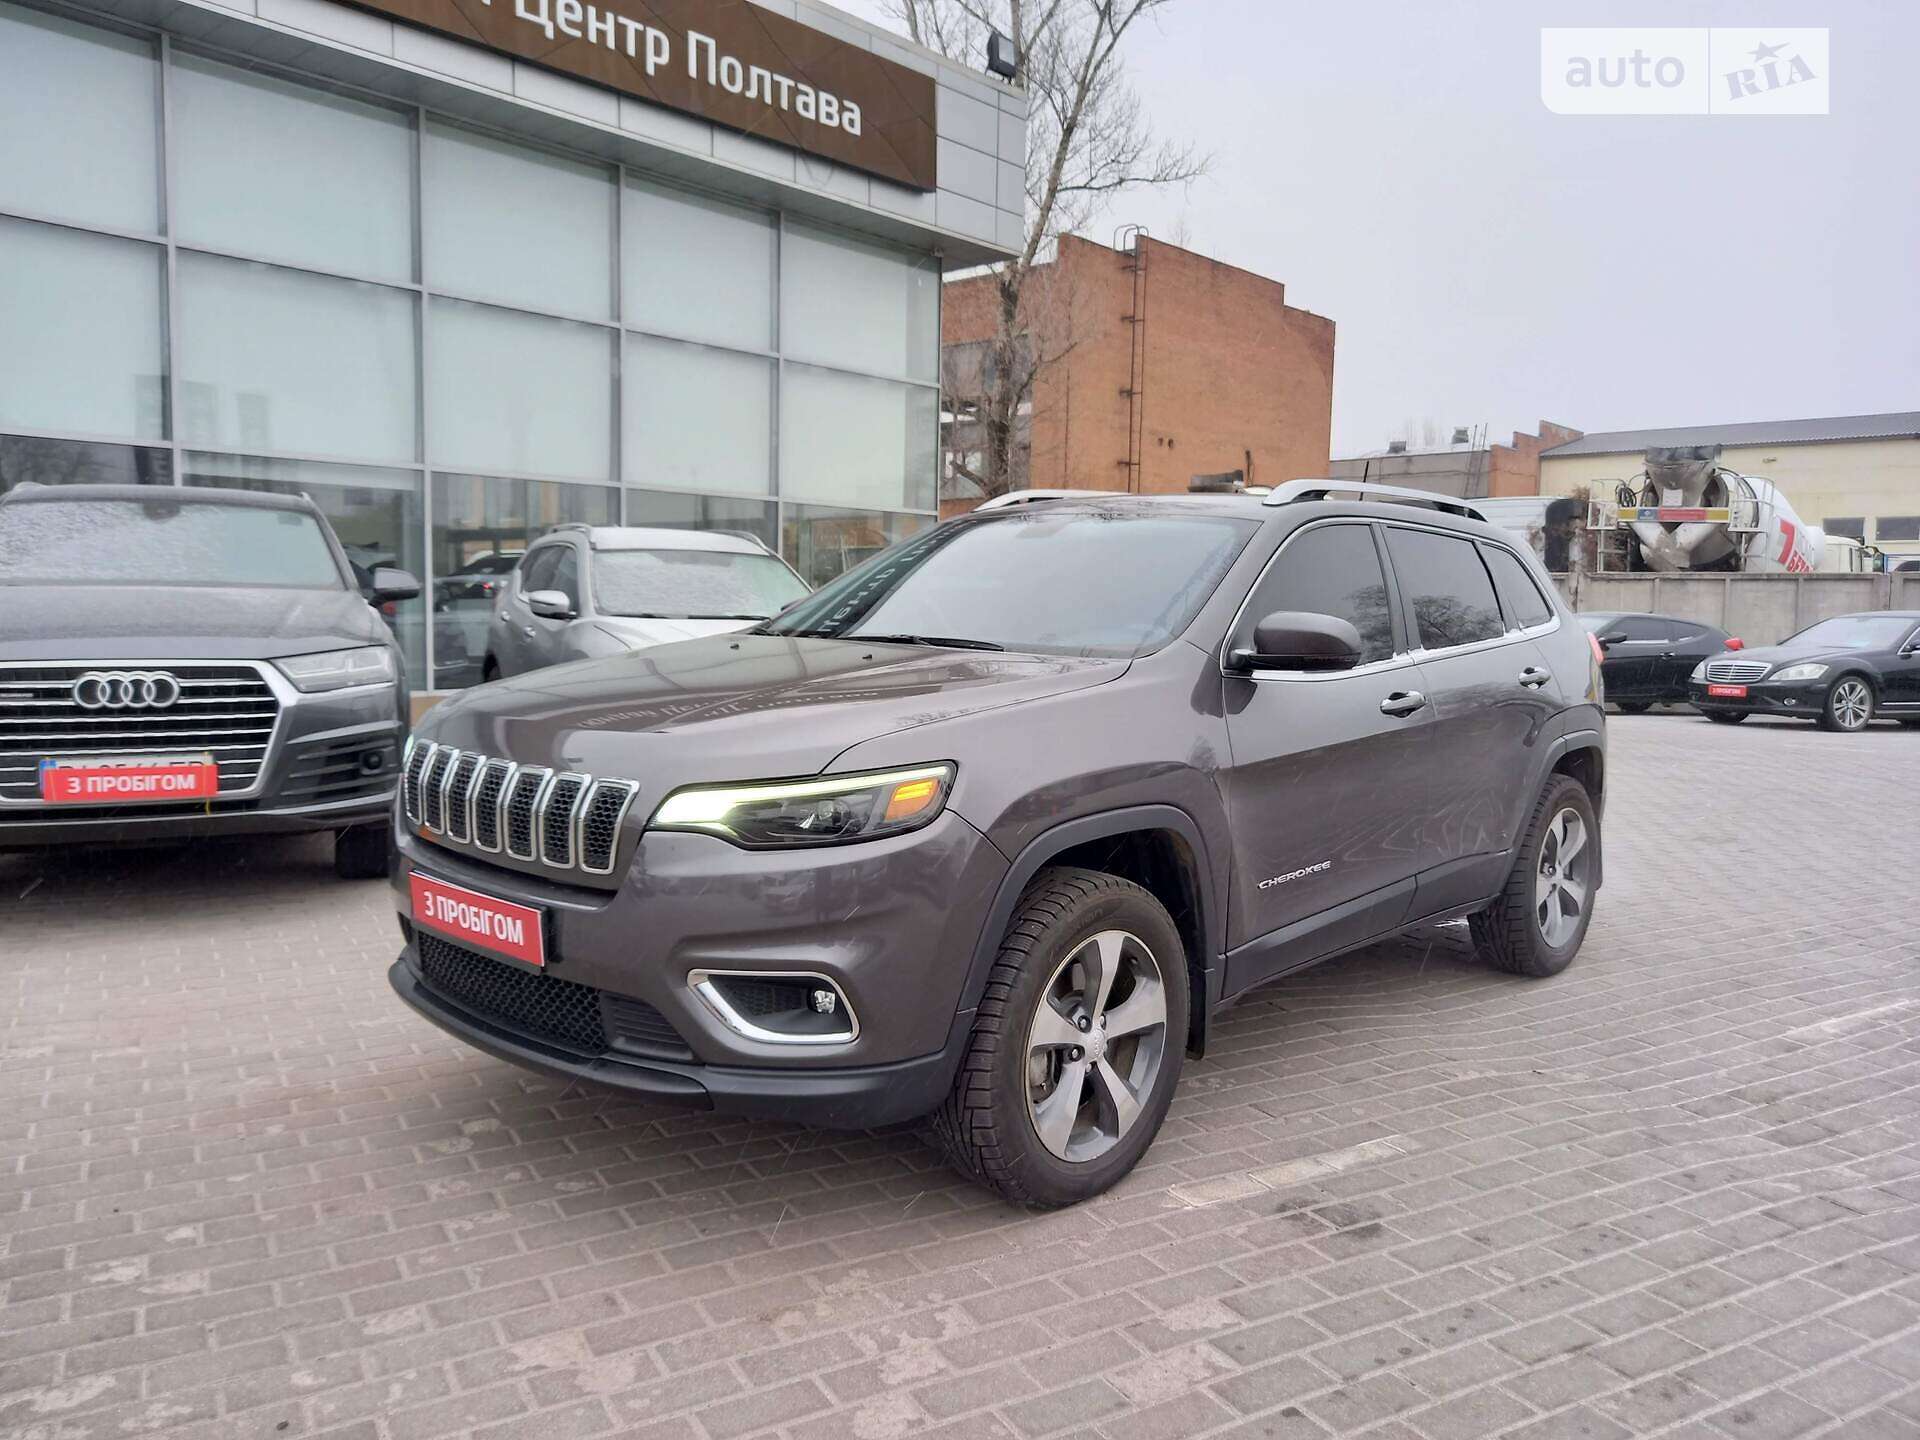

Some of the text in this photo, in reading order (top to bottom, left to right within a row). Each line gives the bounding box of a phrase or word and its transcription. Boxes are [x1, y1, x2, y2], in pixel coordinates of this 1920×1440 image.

[687, 29, 862, 137] Полтава
[87, 774, 196, 793] ПРОБІГОМ
[1258, 860, 1332, 889] CHEROKEE
[436, 895, 525, 946] ПРОБІГОМ
